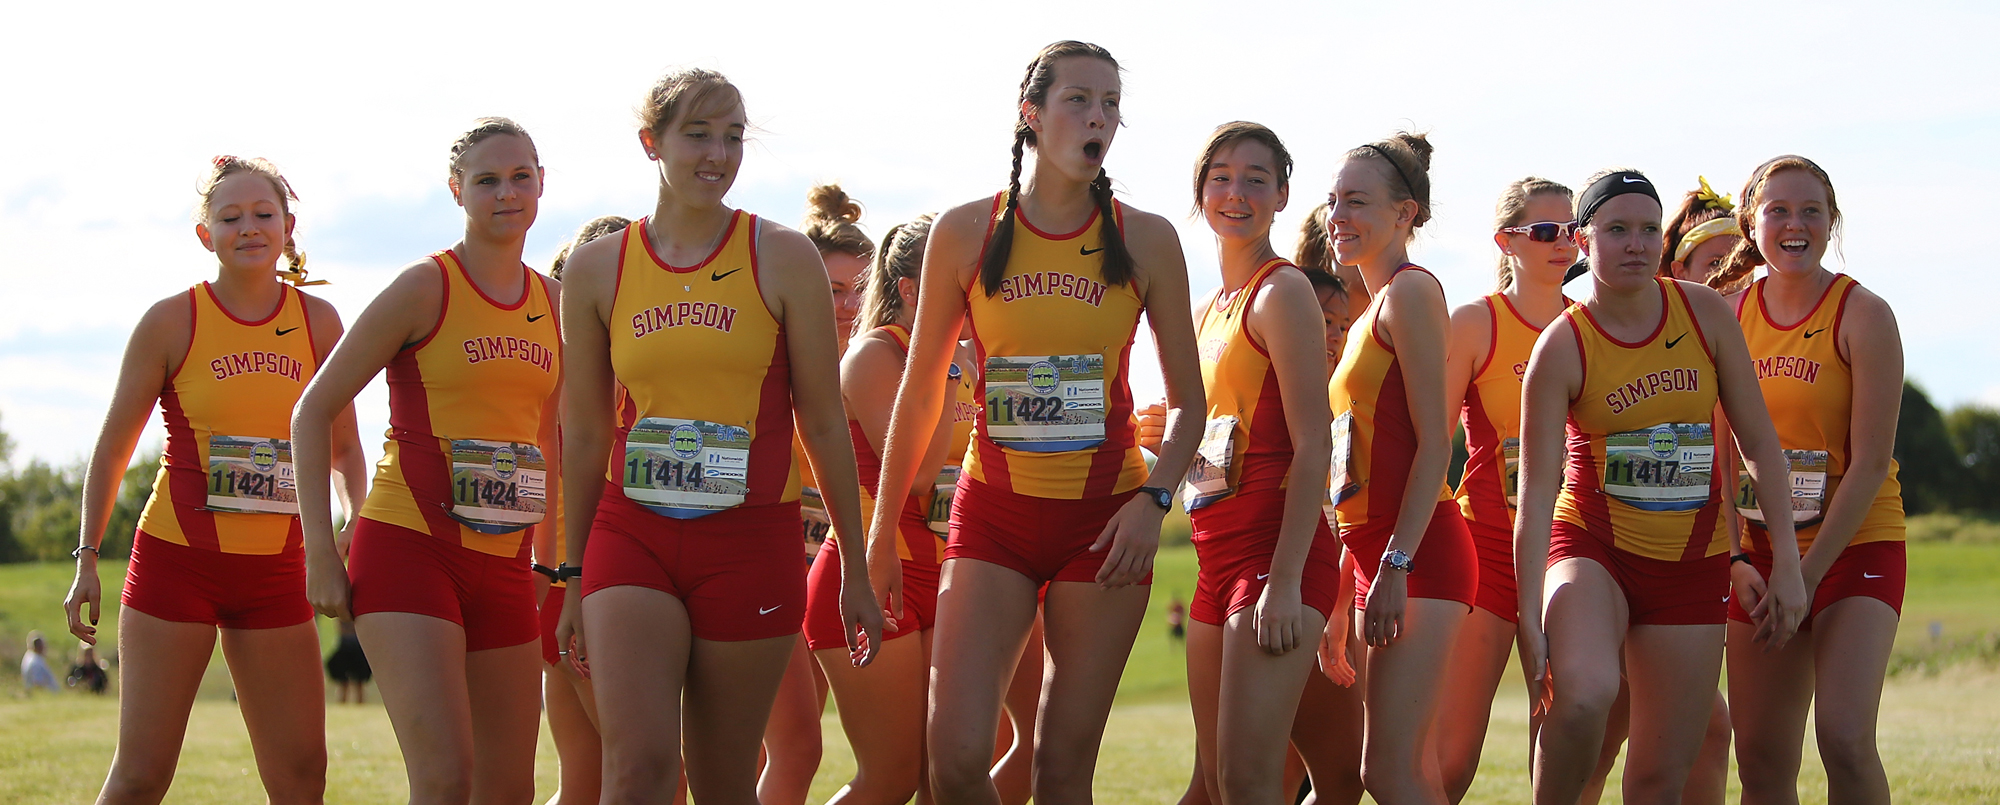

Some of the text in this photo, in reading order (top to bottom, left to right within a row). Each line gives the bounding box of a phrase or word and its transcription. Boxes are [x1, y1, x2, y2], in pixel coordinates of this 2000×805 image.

[1000, 271, 1107, 308] SIMPSON
[631, 301, 737, 339] SIMPSON
[210, 351, 303, 383] SIMPSON
[463, 336, 553, 374] SIMPSON
[1072, 360, 1090, 374] 5K
[1752, 356, 1821, 385] MPSON
[1604, 367, 1699, 415] SIMPSON
[988, 396, 1063, 422] 11422
[716, 427, 735, 441] 5K
[1689, 426, 1704, 440] 5K
[627, 457, 702, 488] 11414
[1608, 459, 1679, 484] 11417
[1801, 453, 1815, 467] 5K
[212, 469, 275, 497] 11421
[456, 477, 517, 507] 11424
